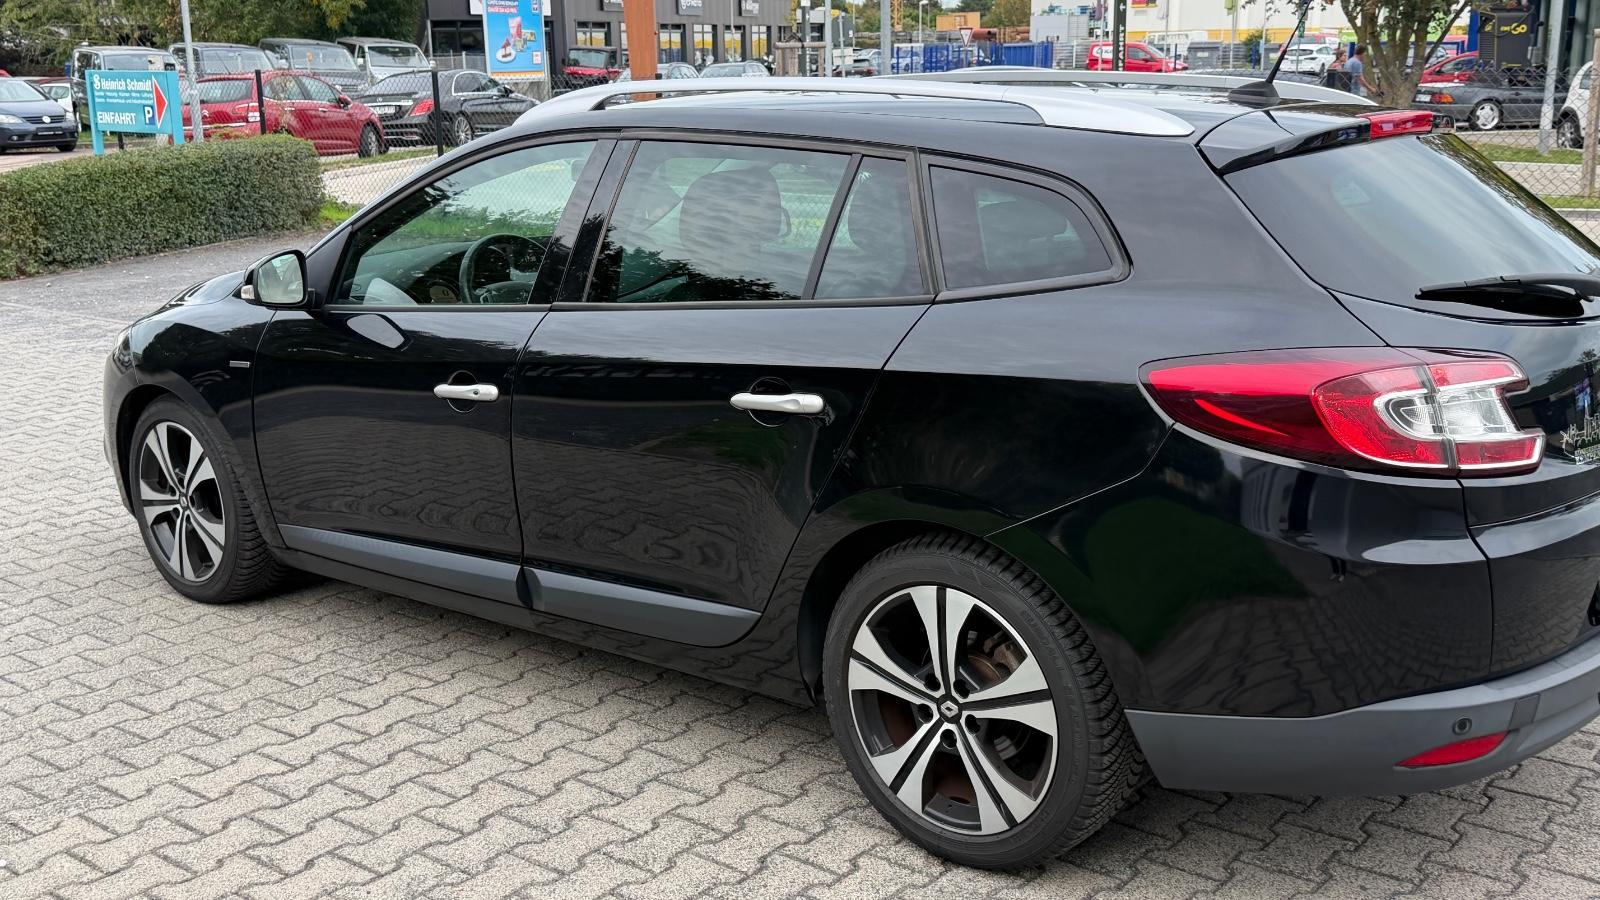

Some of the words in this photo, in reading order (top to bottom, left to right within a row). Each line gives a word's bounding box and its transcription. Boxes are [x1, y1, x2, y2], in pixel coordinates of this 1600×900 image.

[101, 78, 126, 91] Heinrich
[127, 78, 152, 91] Schmidt
[97, 111, 136, 125] EINFAHRT
[144, 106, 153, 123] P
